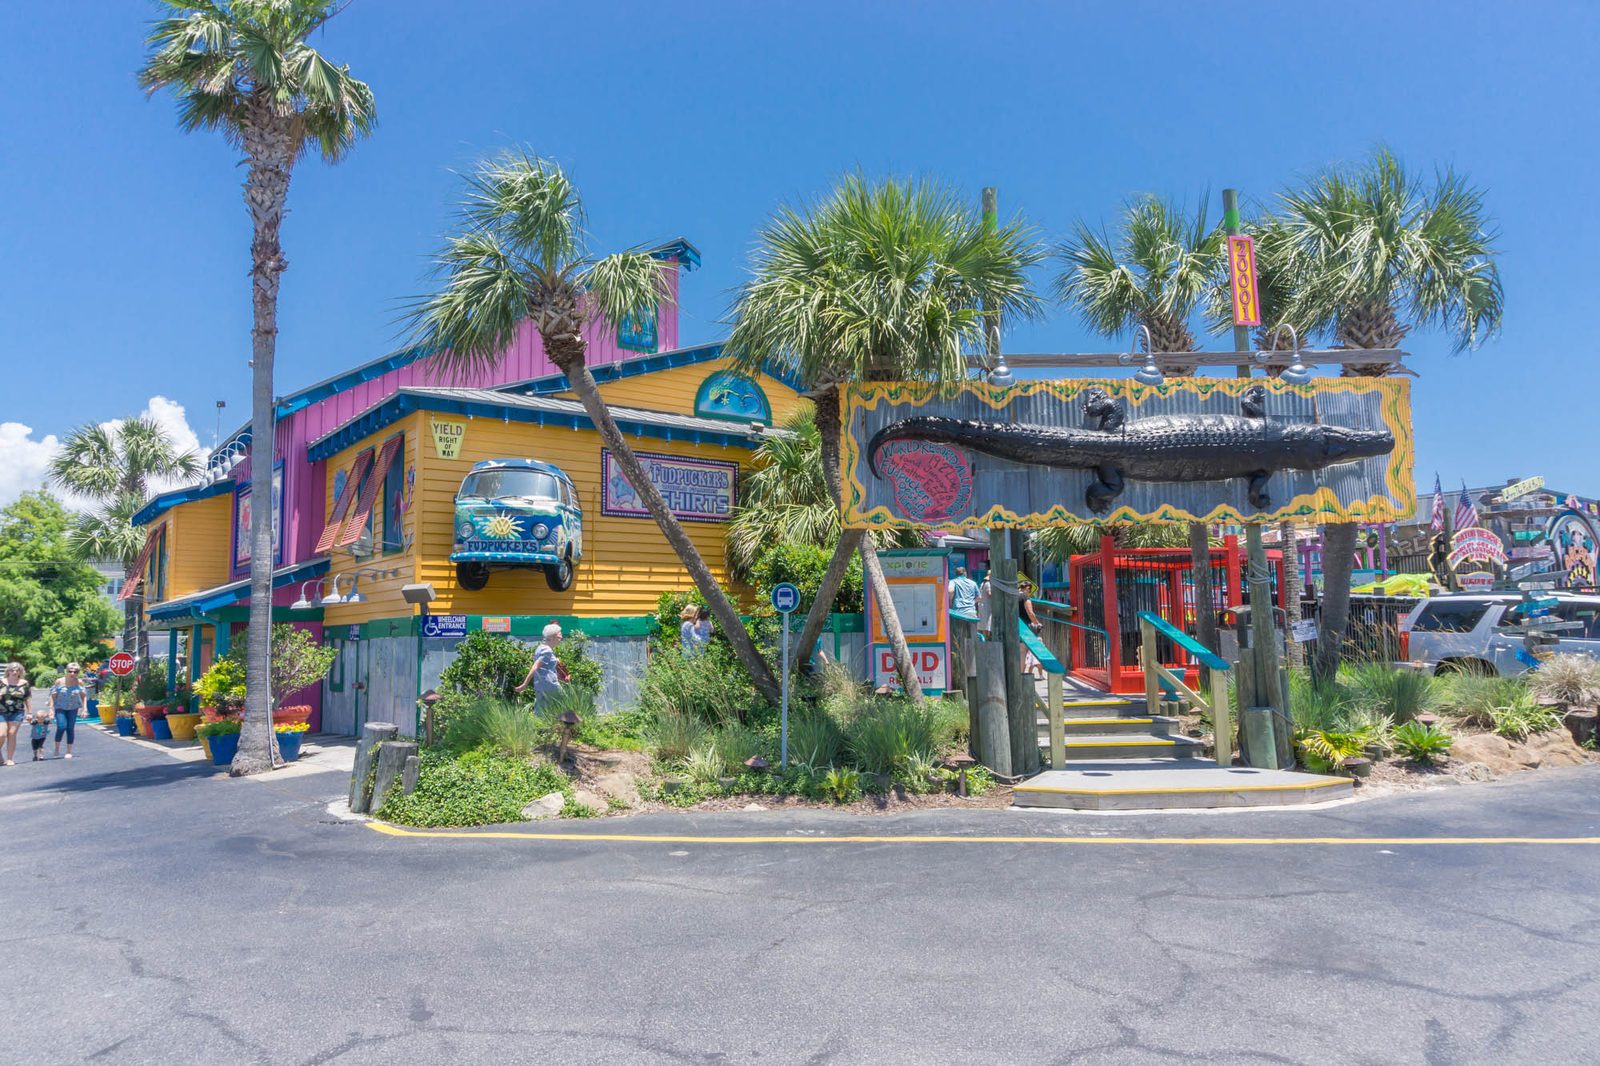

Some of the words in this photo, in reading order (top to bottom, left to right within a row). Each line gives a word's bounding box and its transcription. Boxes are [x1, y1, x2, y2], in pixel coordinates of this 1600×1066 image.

[1236, 241, 1251, 321] 20001
[433, 423, 463, 436] YIELD
[439, 436, 457, 444] RIGHT
[650, 463, 729, 488] FUDPUCKER'S
[111, 659, 133, 669] STOP
